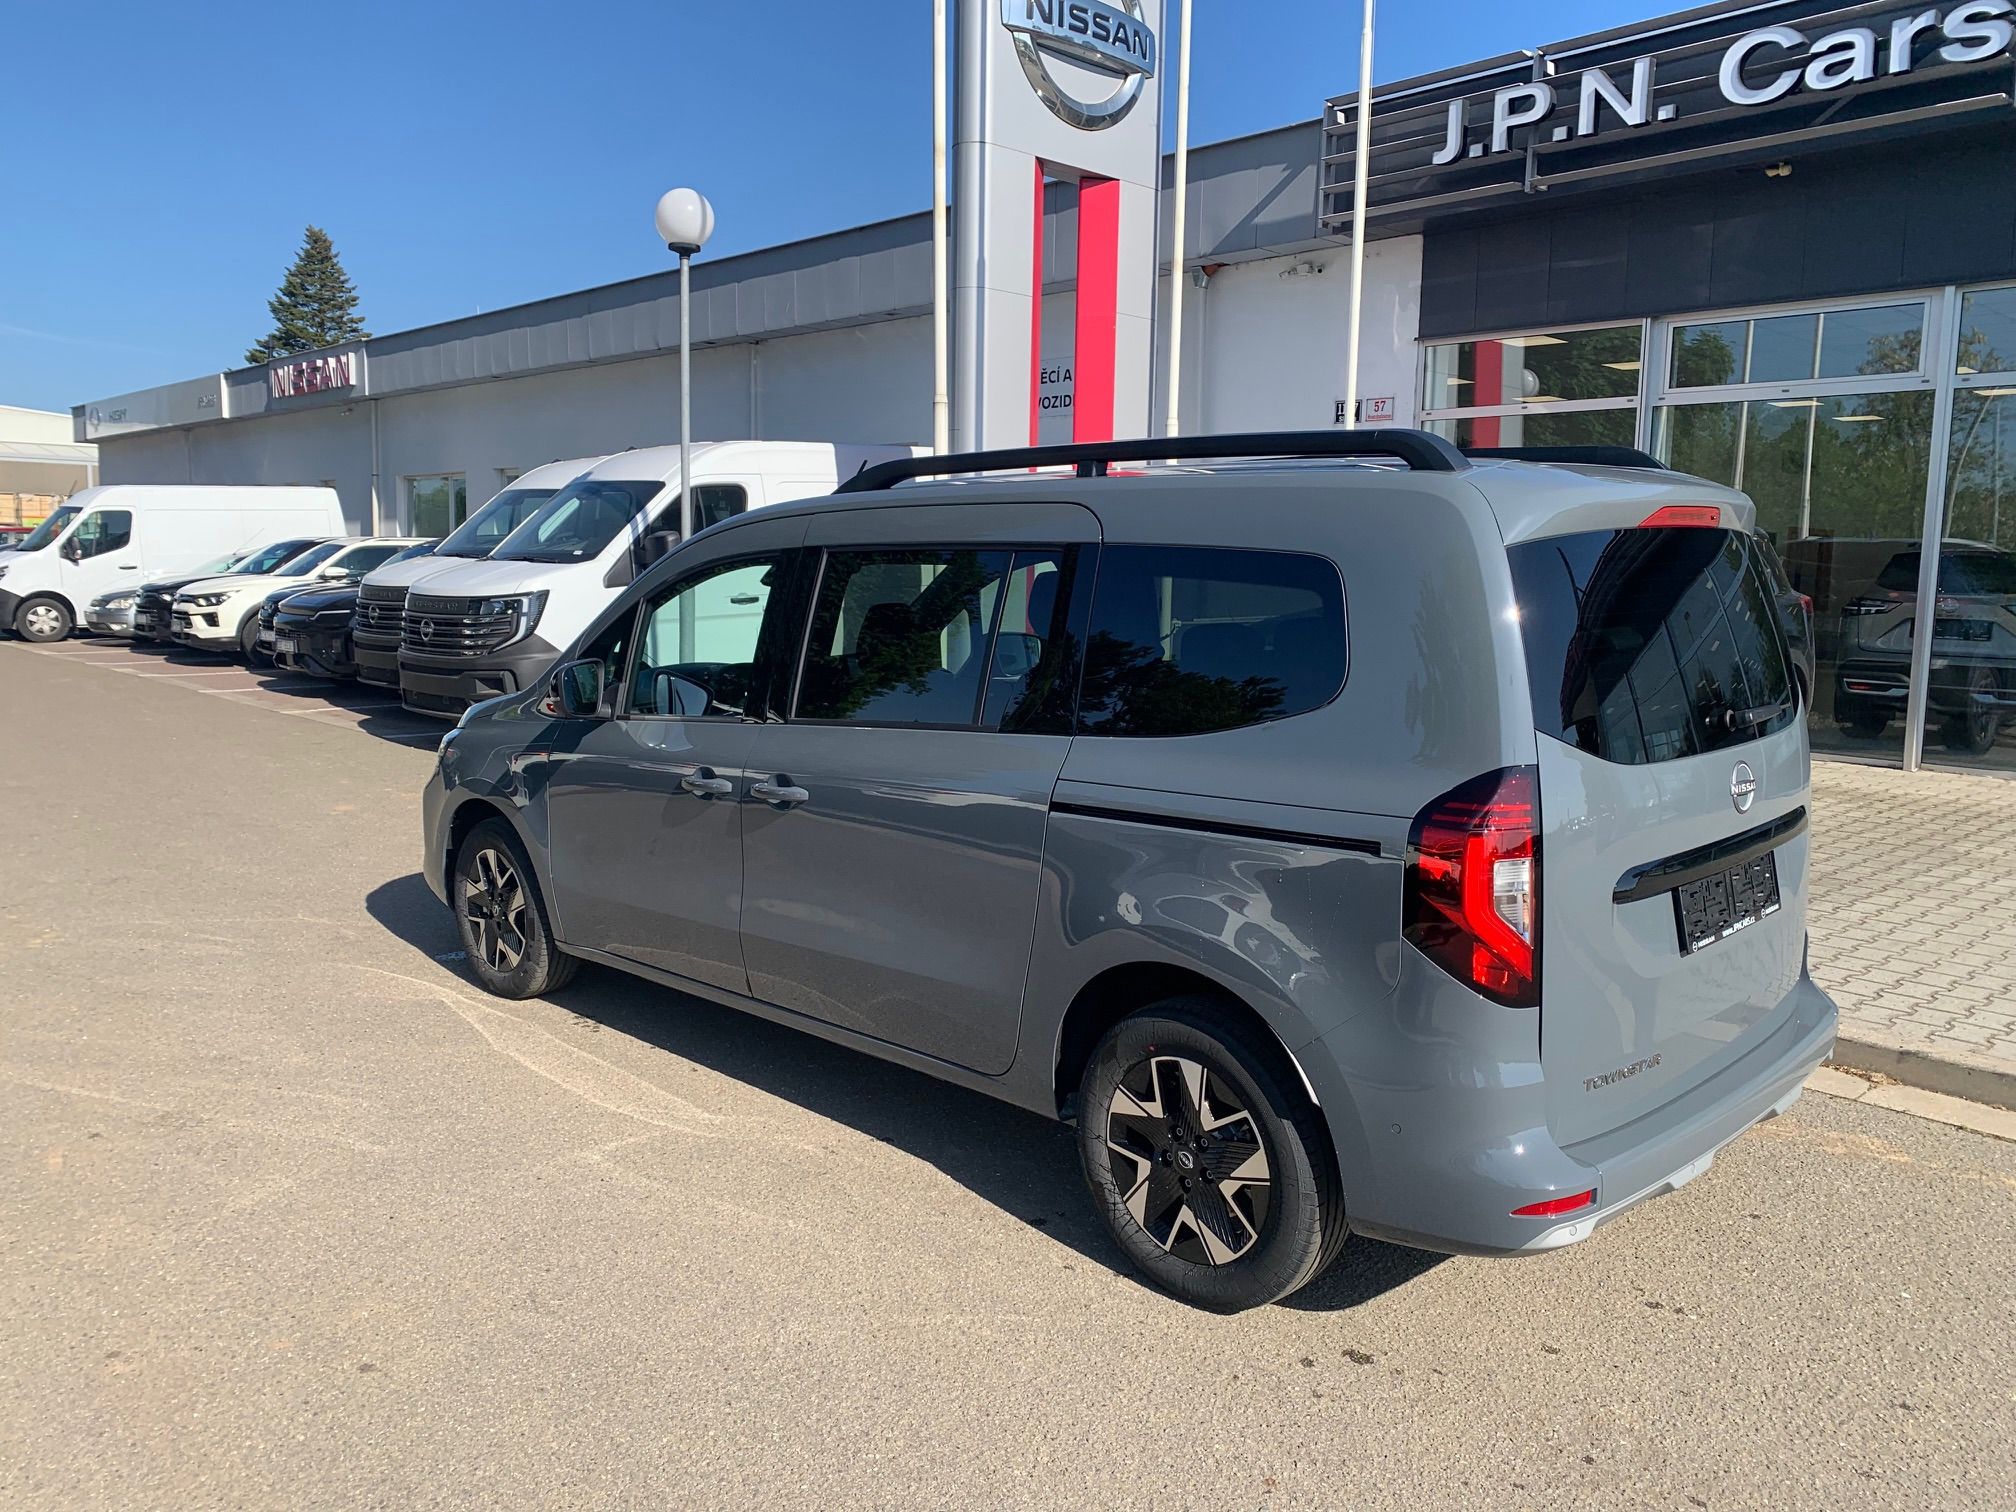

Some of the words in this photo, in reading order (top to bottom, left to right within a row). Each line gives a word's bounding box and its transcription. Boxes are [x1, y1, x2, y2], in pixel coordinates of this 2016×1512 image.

[1026, 0, 1149, 62] NISSAN
[1432, 57, 1677, 165] J.P.N.
[1719, 0, 2014, 105] Cars
[271, 353, 356, 398] NISSAN
[1040, 366, 1060, 384] ĚCÍ
[1039, 395, 1075, 409] OZID
[1374, 401, 1386, 412] 57
[1583, 1053, 1662, 1092] TOWNSTAR
